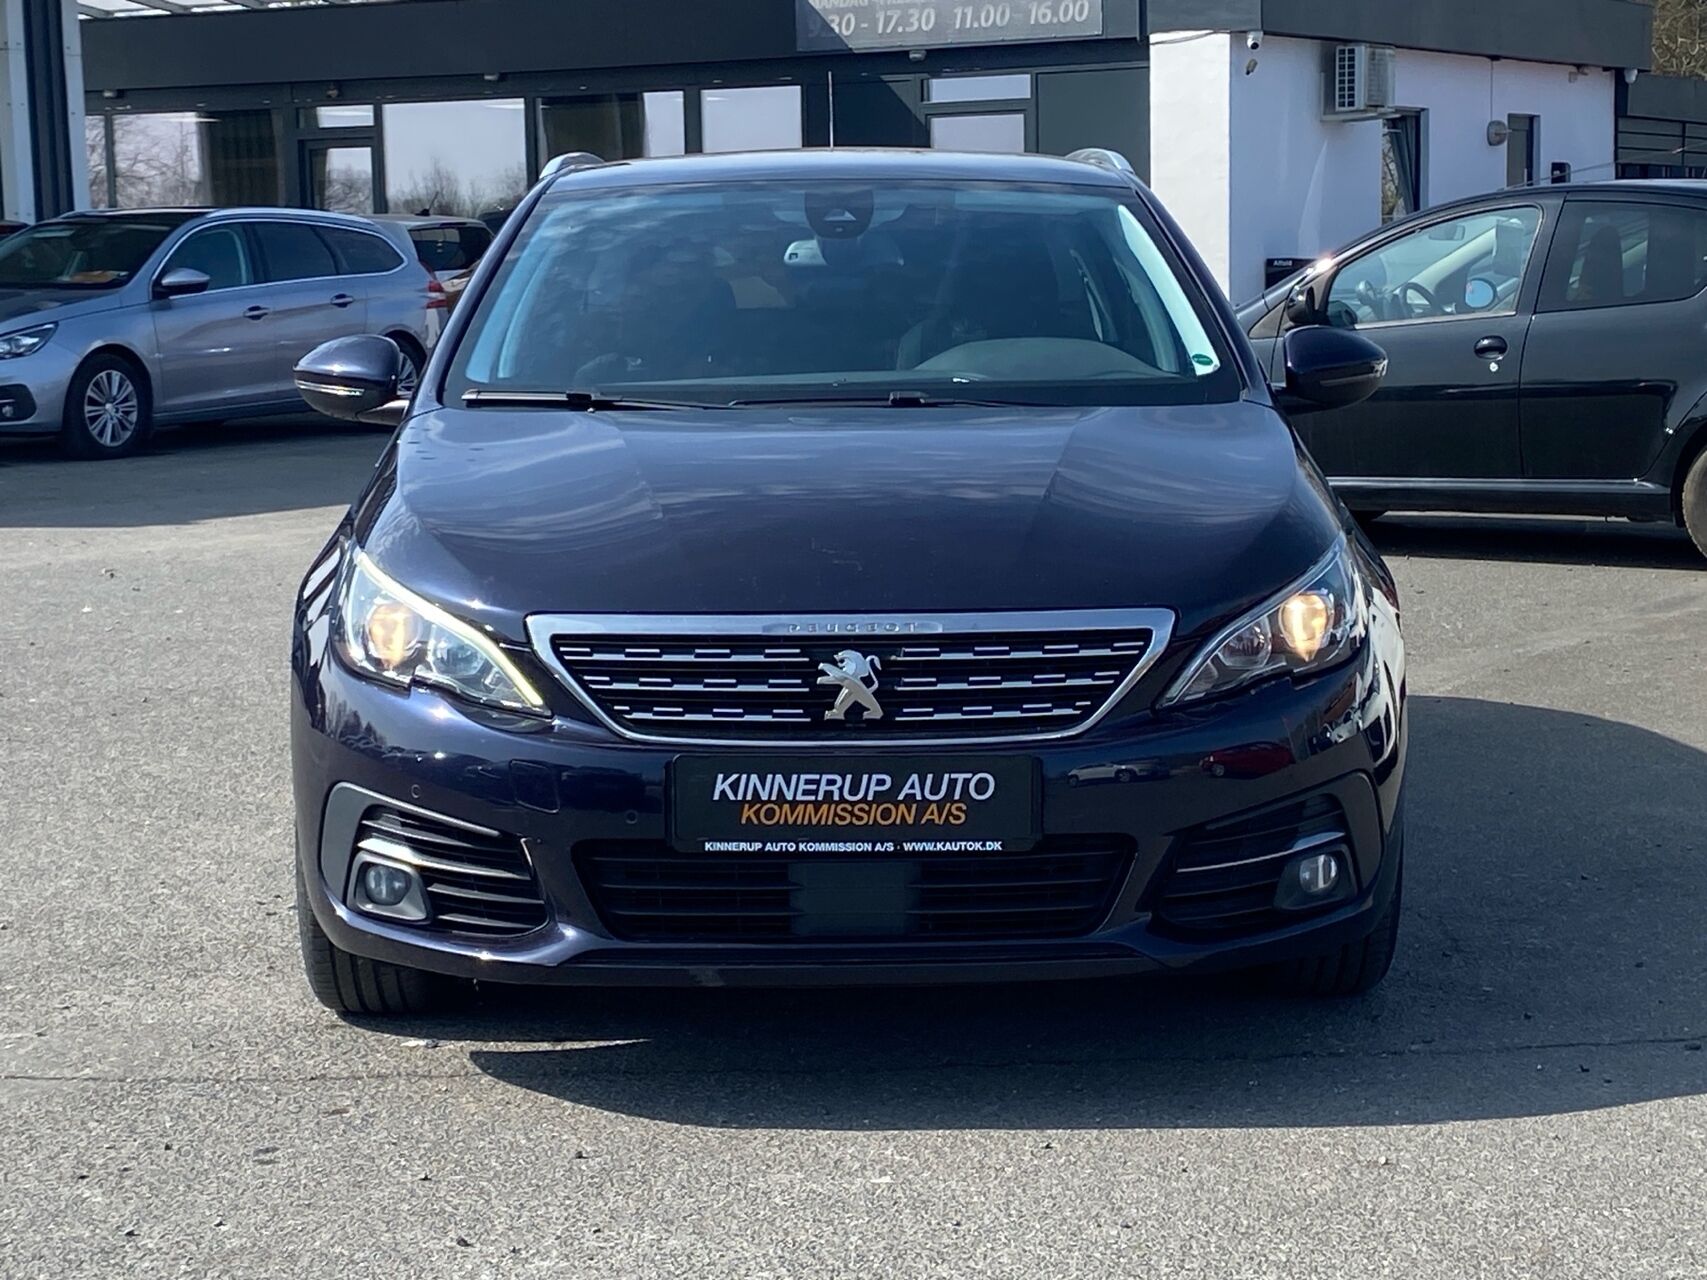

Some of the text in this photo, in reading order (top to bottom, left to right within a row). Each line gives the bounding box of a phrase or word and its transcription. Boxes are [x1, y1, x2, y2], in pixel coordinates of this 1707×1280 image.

[875, 7, 936, 34] 17.30
[953, 3, 1010, 29] 11.00
[1028, 0, 1089, 25] 16.00
[788, 622, 918, 632] PEUGEOT
[712, 772, 996, 801] KINNERUP AUTO
[740, 803, 967, 826] KOMMISSION A/S
[704, 841, 763, 852] KINNERUP
[764, 841, 797, 852] AUTO
[799, 841, 873, 852] KOMMISSION
[874, 841, 895, 852] A/S
[902, 840, 1003, 852] WWW.KAUTOK.DK
